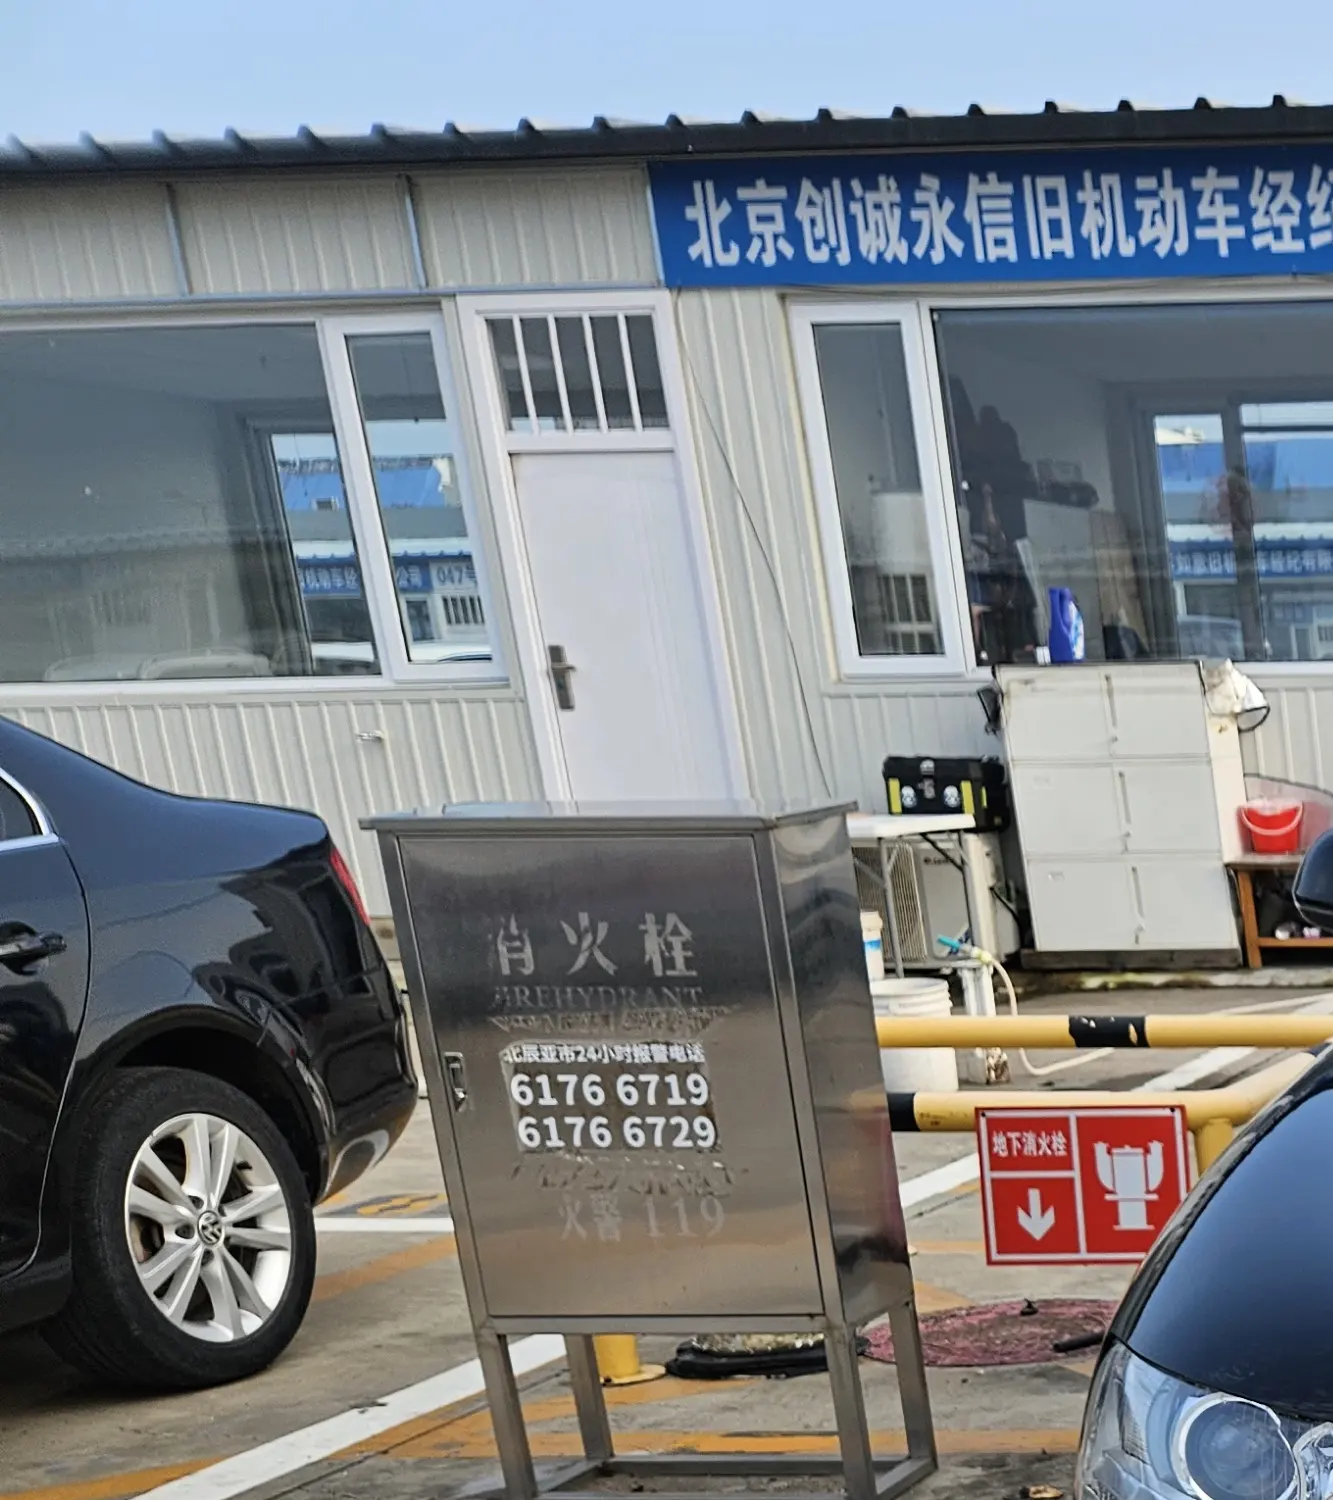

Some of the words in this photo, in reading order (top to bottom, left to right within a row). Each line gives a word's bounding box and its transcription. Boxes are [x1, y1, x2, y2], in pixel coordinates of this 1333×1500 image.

[511, 1073, 605, 1106] 6176
[616, 1073, 709, 1106] 6719
[518, 1116, 612, 1148] 6176
[623, 1116, 716, 1148] 6729
[991, 1130, 1068, 1158] 地下消火栓
